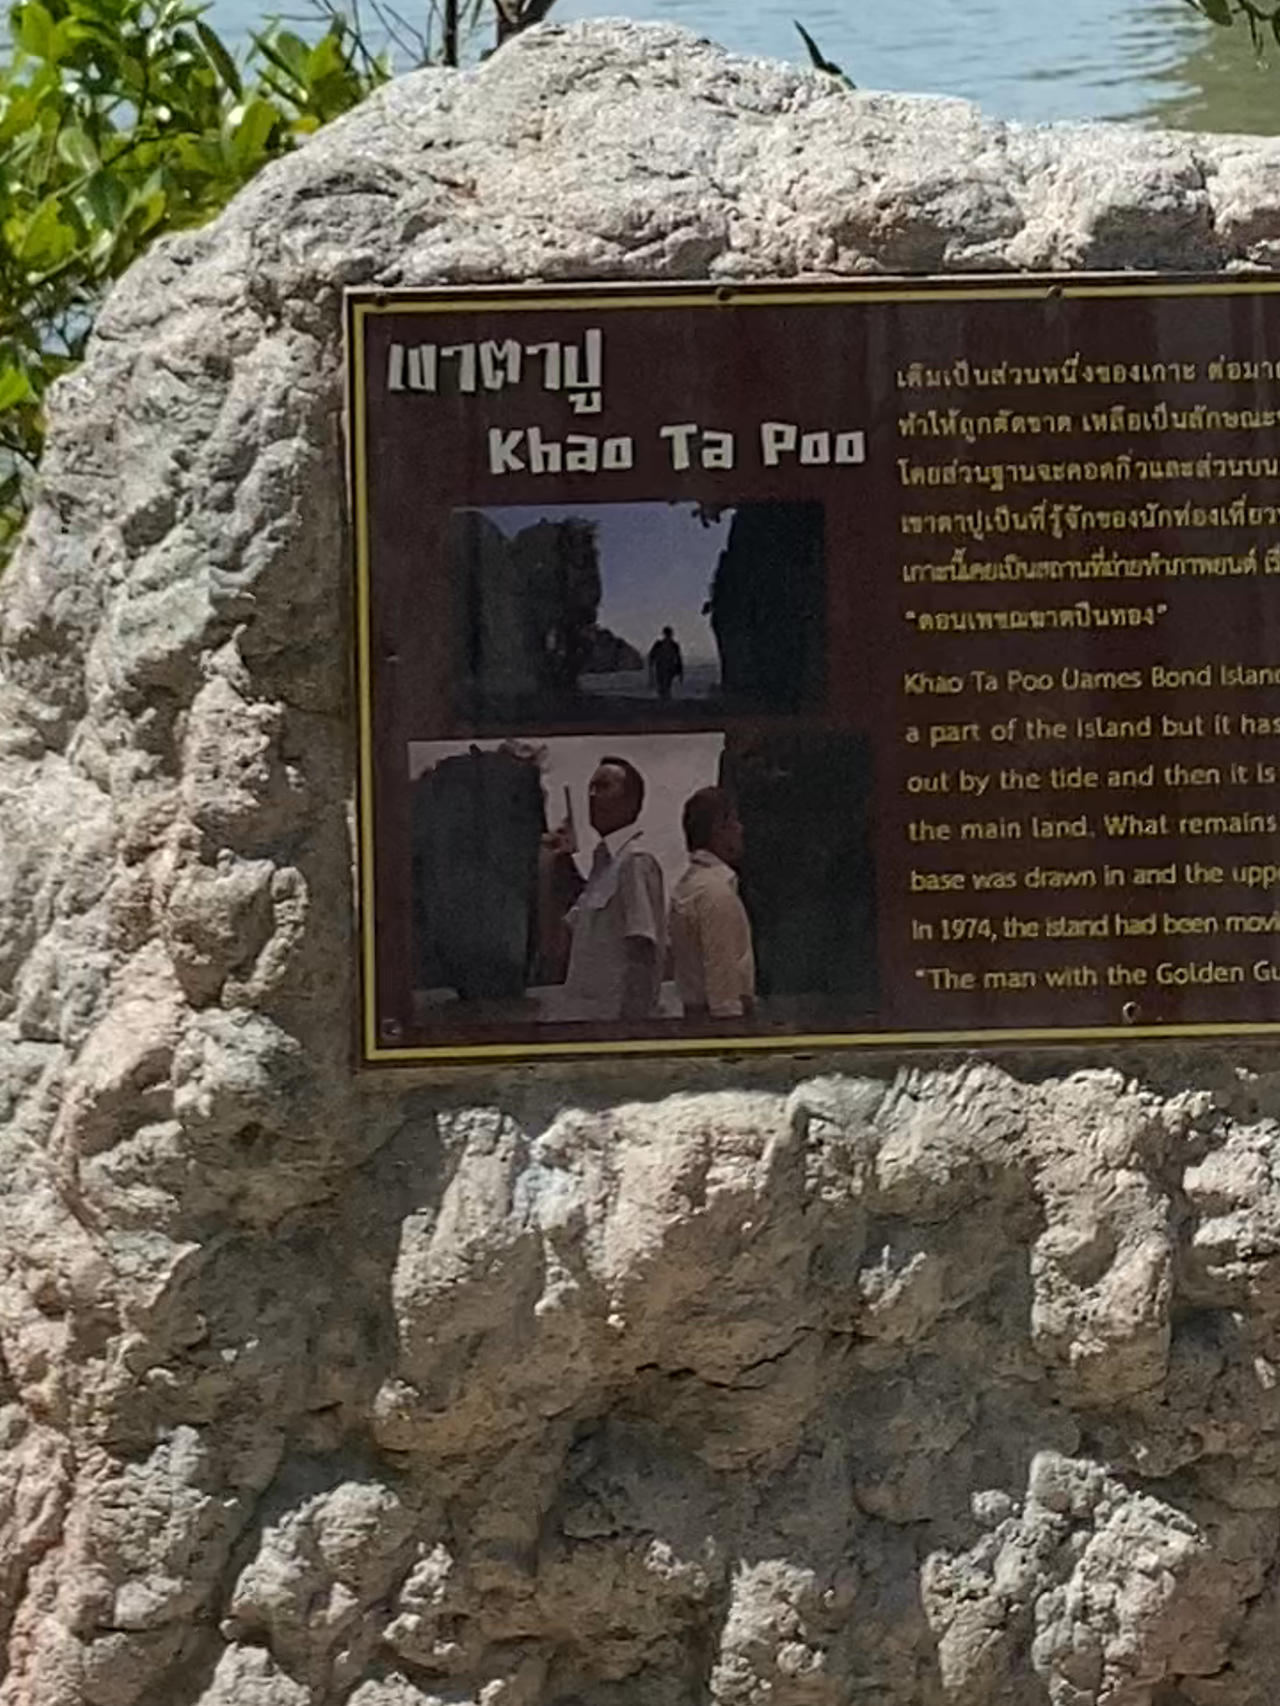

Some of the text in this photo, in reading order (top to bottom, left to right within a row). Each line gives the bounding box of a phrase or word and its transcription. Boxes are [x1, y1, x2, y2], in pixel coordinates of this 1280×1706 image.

[388, 328, 603, 414] เขาตาปู
[488, 421, 866, 475] Khao Ta Poo
[904, 671, 963, 694] Khao
[971, 670, 998, 693] Ta
[1007, 669, 1054, 692] Poo
[1061, 667, 1143, 691] (James
[1151, 664, 1212, 688] Bond
[905, 725, 920, 744] a
[930, 723, 980, 748] part
[990, 717, 1018, 742] of
[1026, 717, 1068, 740] the
[1162, 714, 1204, 737] but
[1214, 713, 1231, 736] it
[907, 770, 950, 793] out
[959, 769, 991, 797] by
[1000, 768, 1041, 791] the
[1051, 767, 1099, 789] tide
[1107, 765, 1156, 788] and
[1164, 763, 1221, 786] then
[1230, 762, 1249, 785] it
[908, 819, 951, 842] the
[961, 817, 1021, 840] main
[1032, 815, 1096, 838] land.
[1103, 814, 1168, 836] What
[1179, 811, 1278, 835] remains
[910, 869, 966, 892] base
[972, 871, 1018, 890] was
[1024, 866, 1097, 889] drawn
[1103, 864, 1126, 886] in
[1132, 863, 1178, 885] and
[1184, 861, 1224, 884] the
[912, 919, 933, 940] In
[940, 917, 998, 944] 1974,
[1003, 915, 1039, 938] the
[1114, 912, 1157, 936] had
[1163, 911, 1219, 934] been
[983, 968, 1037, 989] man
[1044, 965, 1098, 988] with
[1107, 963, 1148, 986] the
[1156, 961, 1245, 986] Golden
